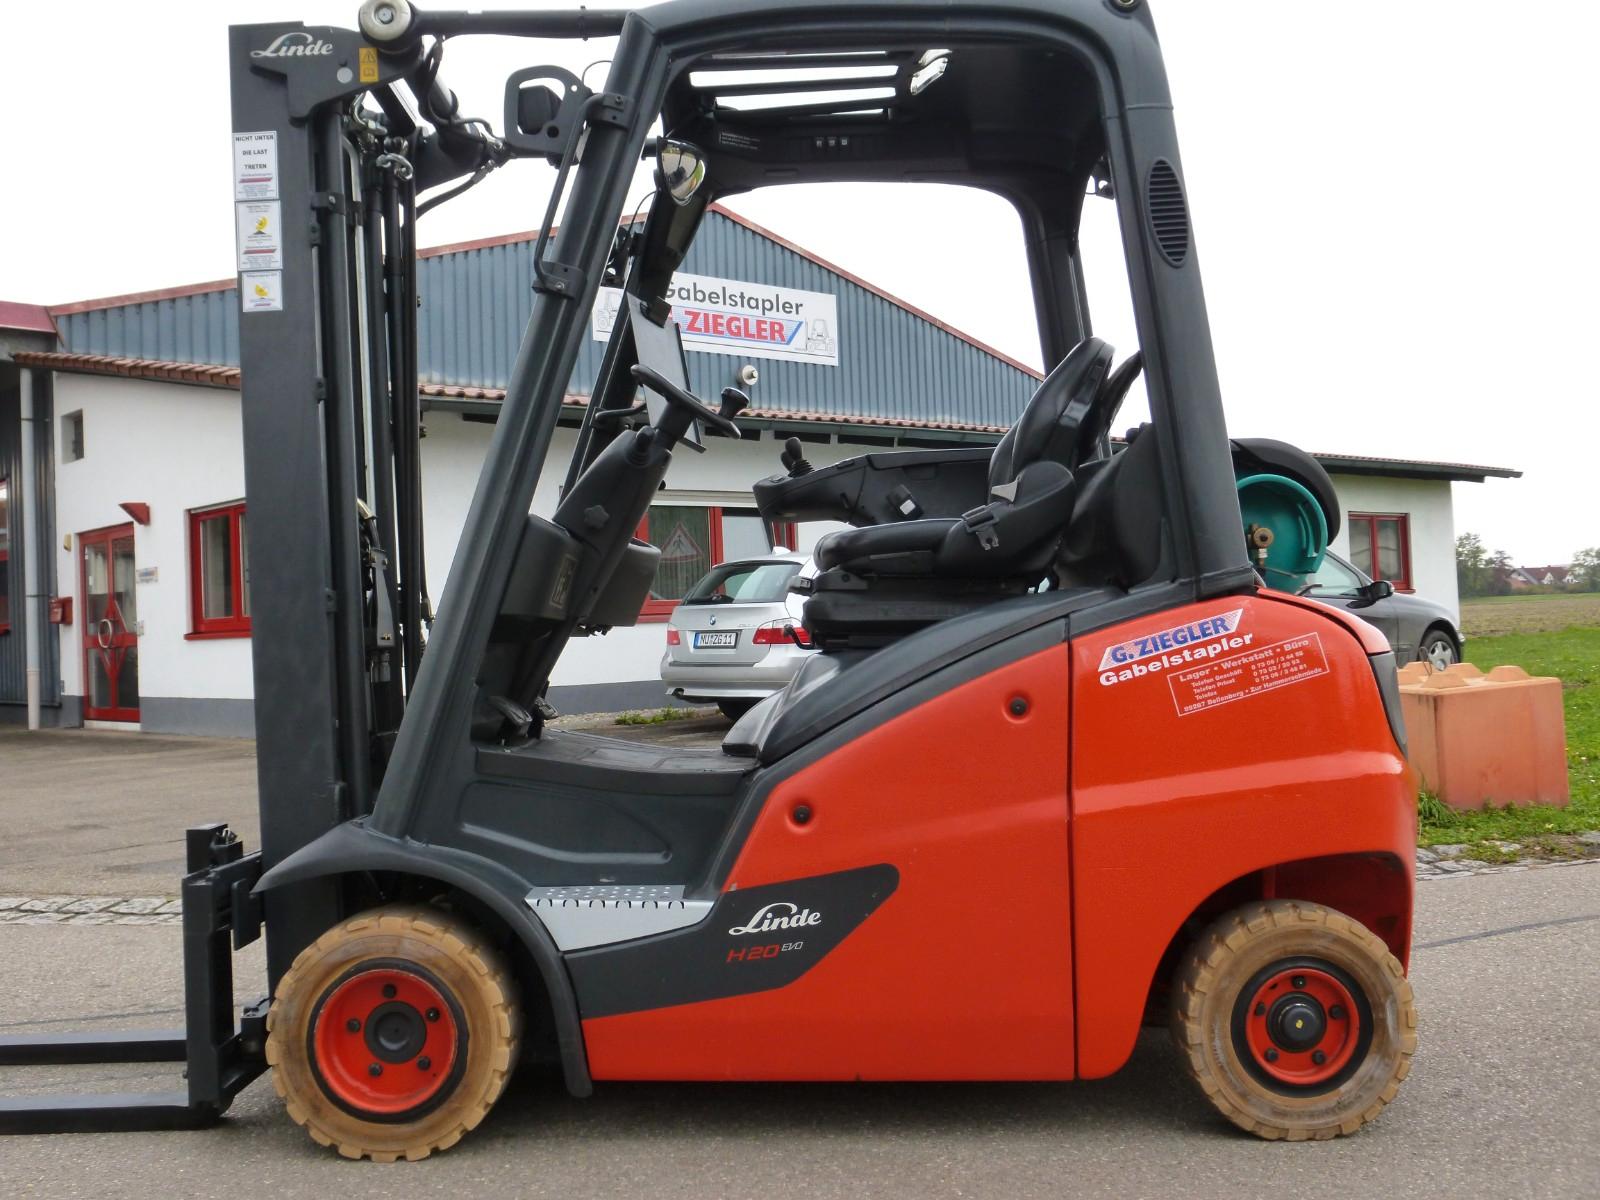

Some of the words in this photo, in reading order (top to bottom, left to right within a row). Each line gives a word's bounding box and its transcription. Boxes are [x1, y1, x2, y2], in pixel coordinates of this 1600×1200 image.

[250, 32, 334, 58] Linde
[685, 310, 788, 343] ZIEGLER
[1099, 633, 1253, 686] Gabelstapler
[1180, 669, 1210, 682] Lager
[1221, 650, 1273, 669] Werkstatt
[1284, 640, 1309, 651] Büro
[1192, 678, 1215, 687] Telefon
[1193, 684, 1216, 694] Telefon
[728, 902, 822, 935] Linde
